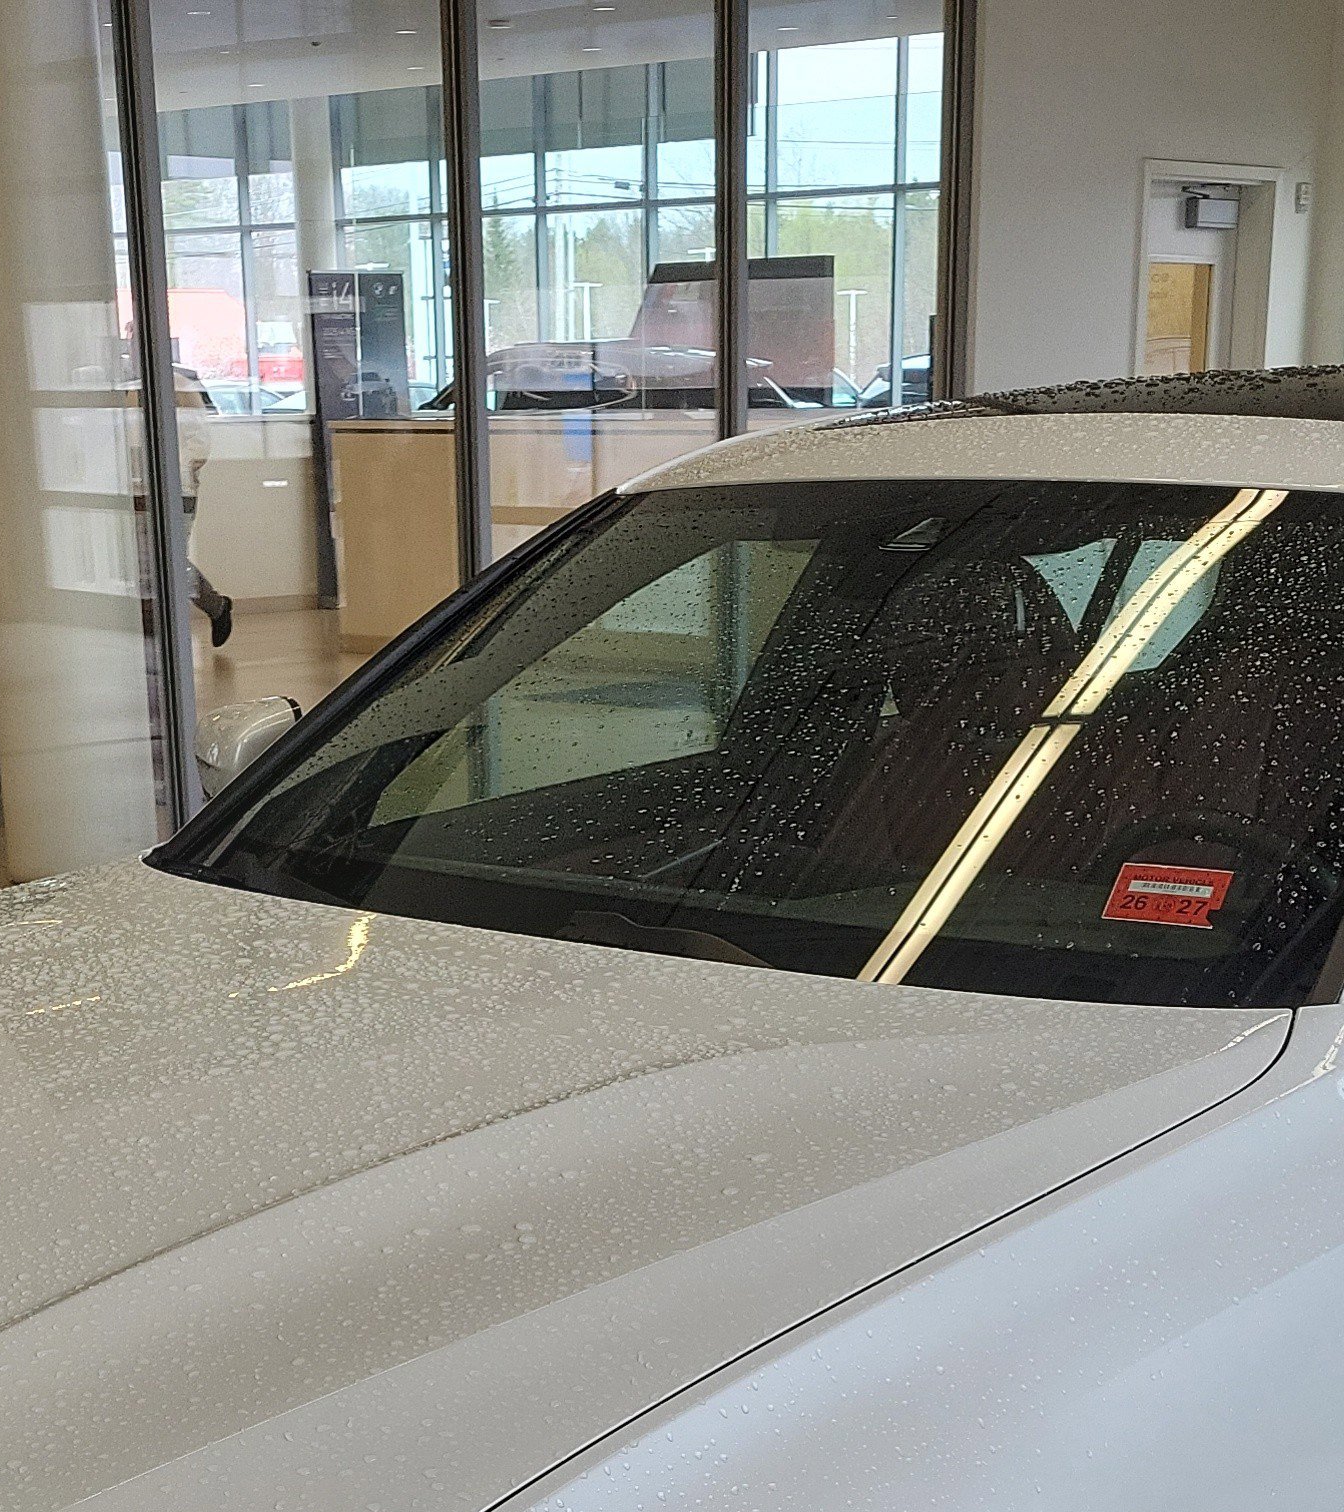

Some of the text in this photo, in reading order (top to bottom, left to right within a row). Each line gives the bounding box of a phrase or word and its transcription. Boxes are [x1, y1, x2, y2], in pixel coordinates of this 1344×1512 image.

[1133, 873, 1170, 882] MOTOR
[1119, 894, 1149, 911] 26
[1176, 898, 1208, 916] 27
